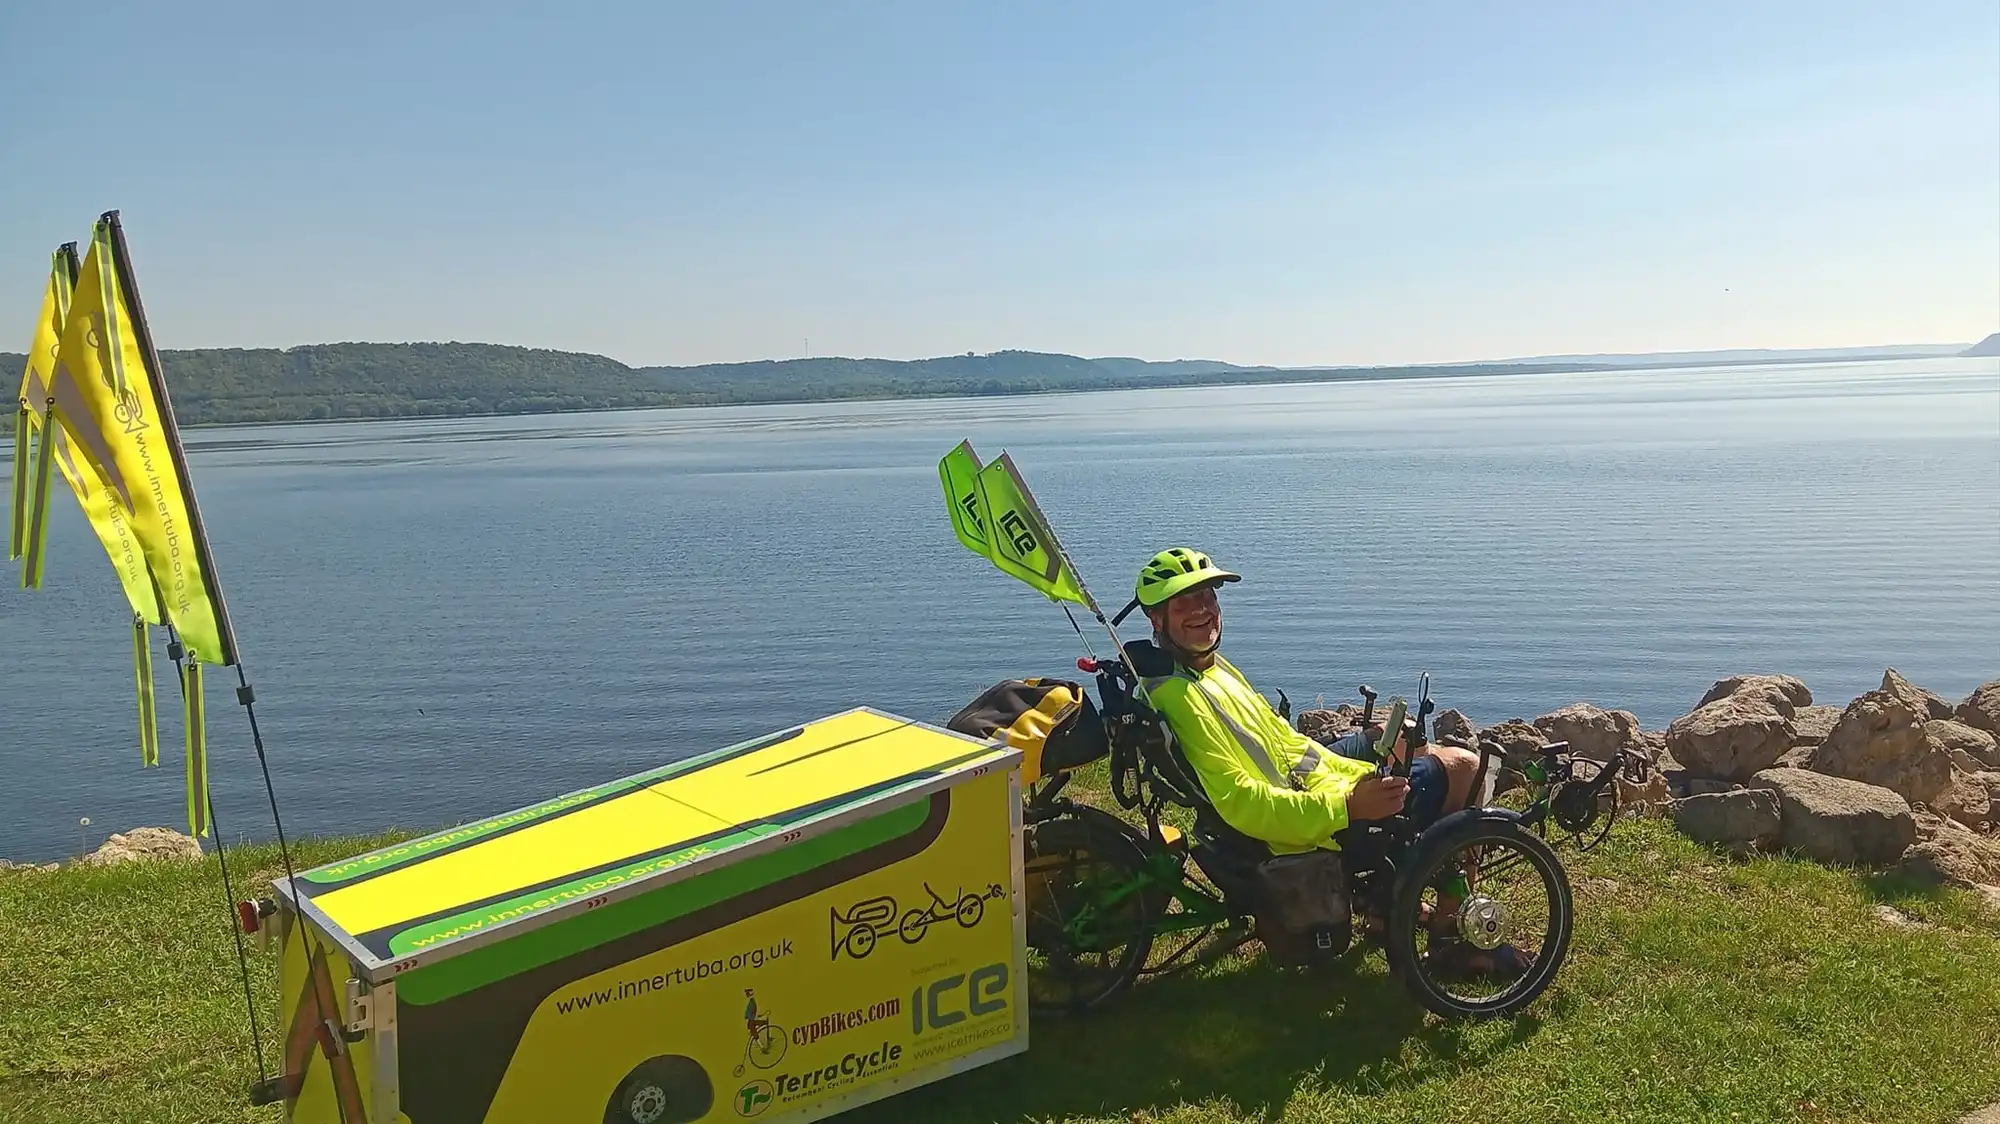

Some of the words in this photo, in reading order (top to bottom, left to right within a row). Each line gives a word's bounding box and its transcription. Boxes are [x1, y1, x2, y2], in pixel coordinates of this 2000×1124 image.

[136, 432, 191, 615] www.innertuba.org.uk
[326, 791, 598, 876] www.innertuba.org.uk
[411, 845, 713, 948] www.innertuba.org.uk
[556, 938, 793, 1015] www.innertuba.org.uk
[792, 998, 900, 1046] cypBikes.com
[775, 1041, 902, 1097] TerraCycle
